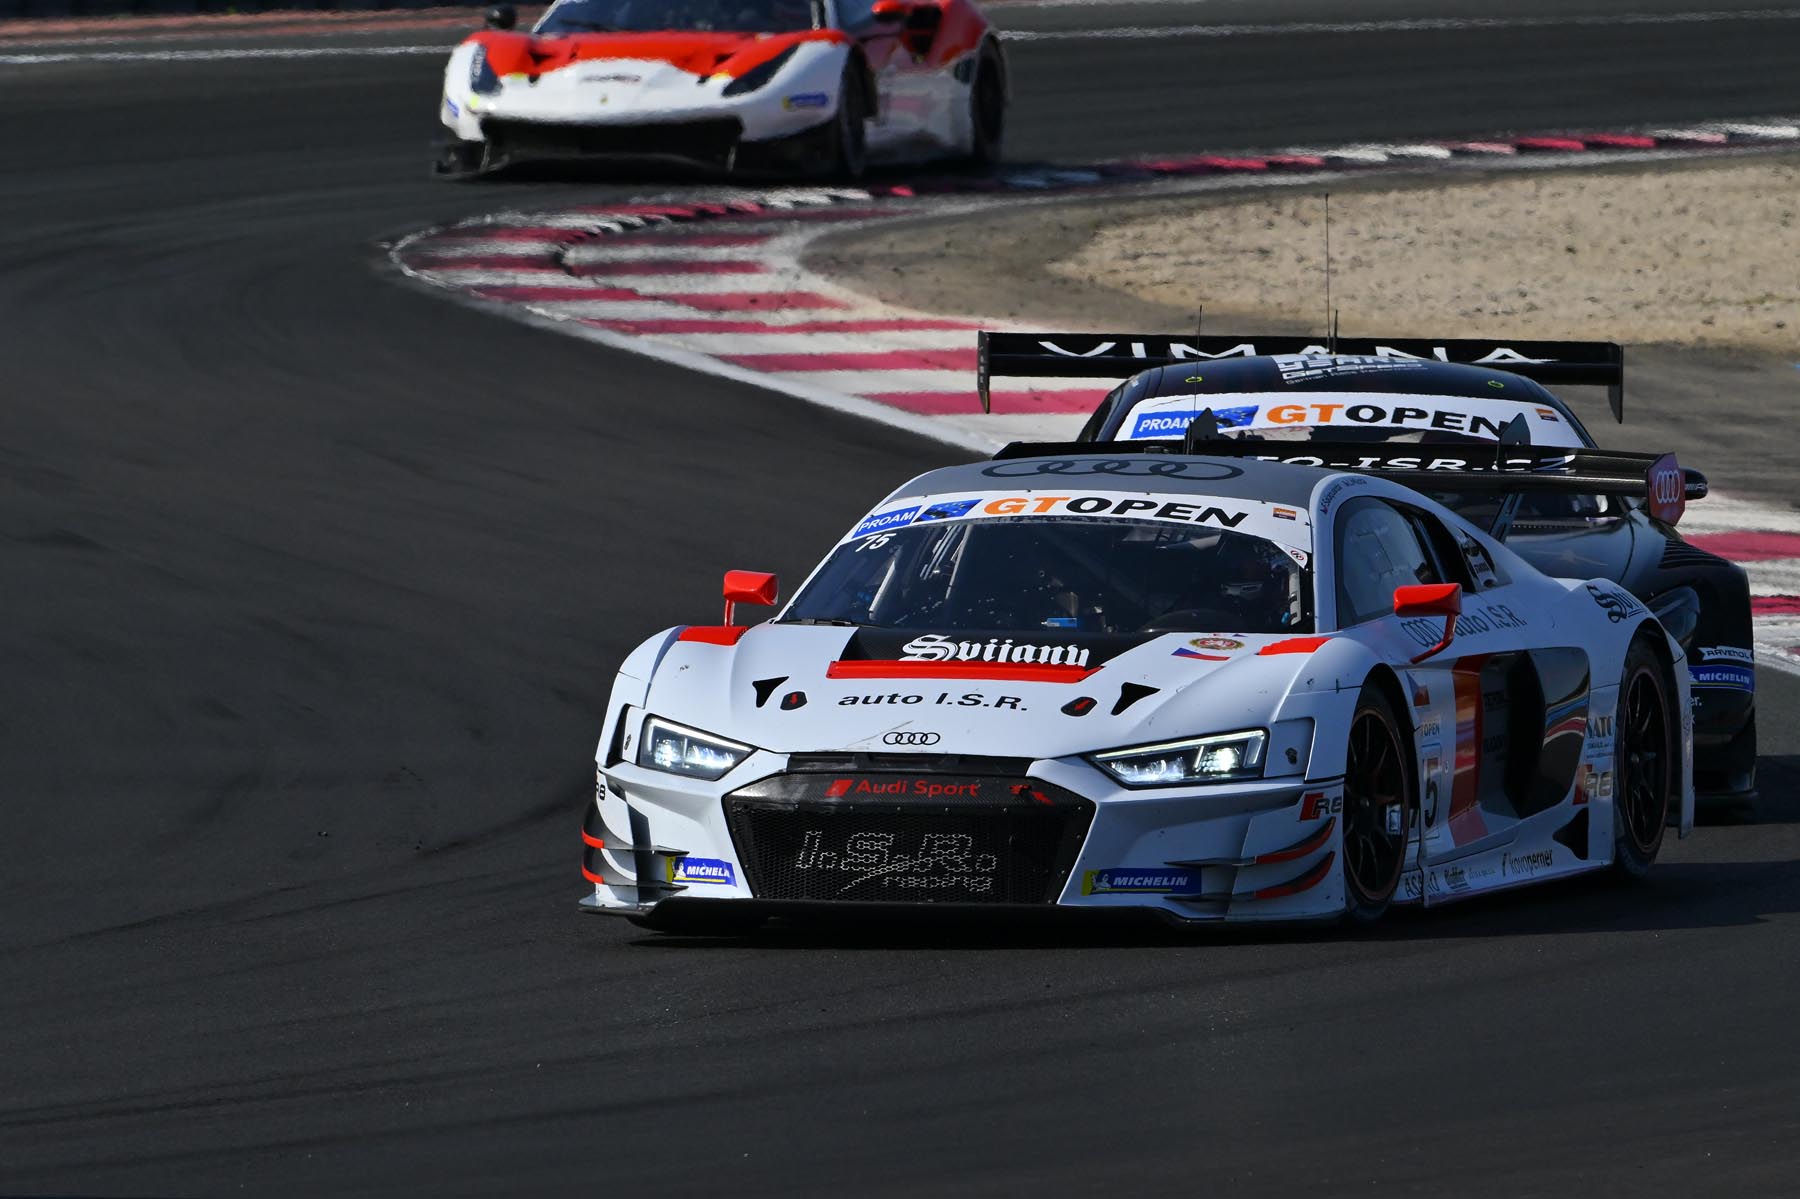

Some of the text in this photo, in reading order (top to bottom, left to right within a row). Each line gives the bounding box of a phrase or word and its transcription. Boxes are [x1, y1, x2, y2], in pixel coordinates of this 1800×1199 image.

[858, 496, 1249, 534] PROAM GTOPEN
[855, 532, 896, 552] 75
[1454, 616, 1483, 636] auto
[1699, 671, 1750, 686] MICHELIN
[838, 692, 1028, 712] auto I.S.R.
[856, 779, 980, 798] Audi Sport
[1112, 874, 1190, 888] MICHELIN
